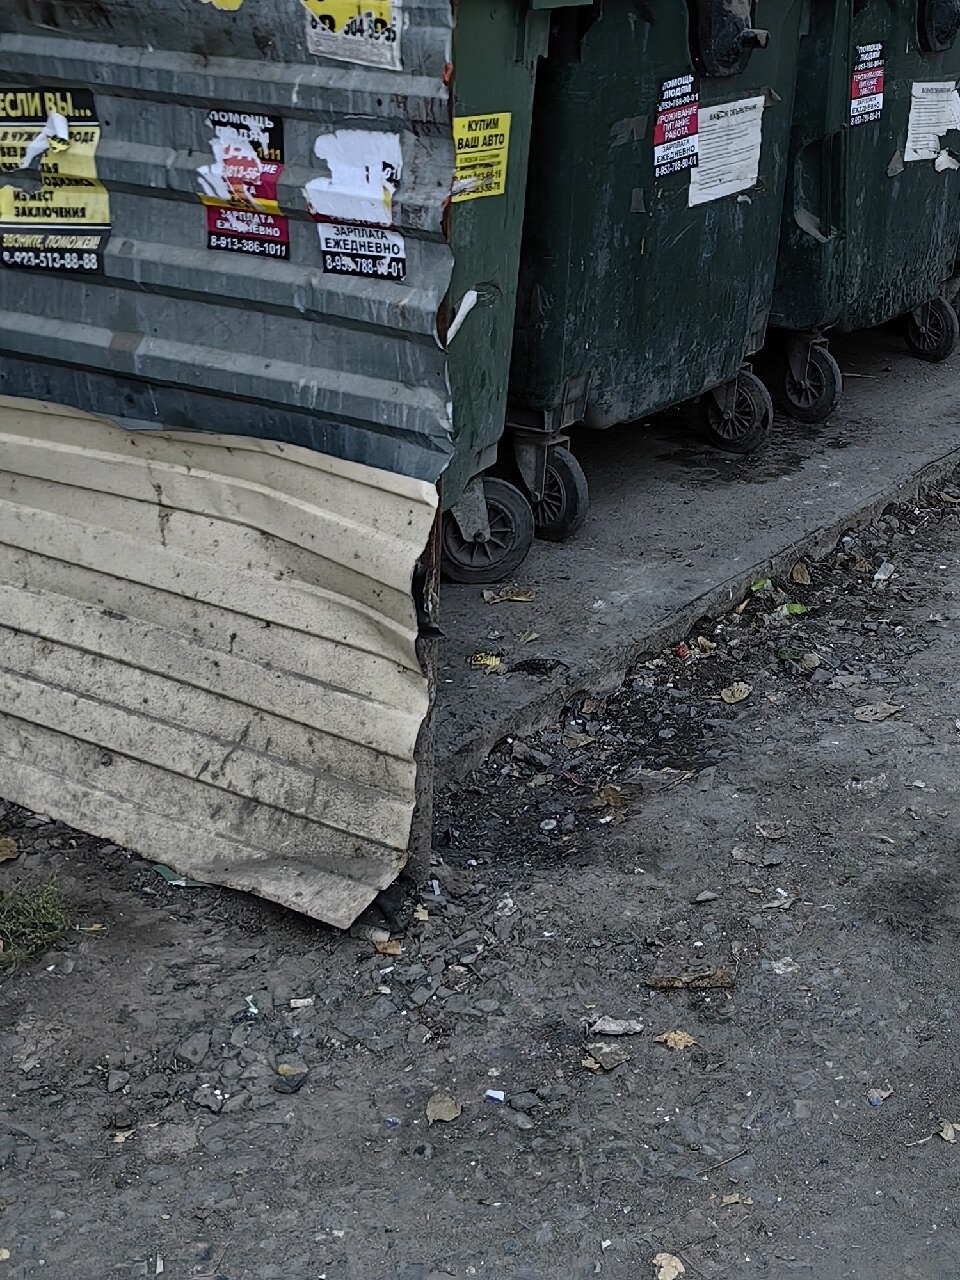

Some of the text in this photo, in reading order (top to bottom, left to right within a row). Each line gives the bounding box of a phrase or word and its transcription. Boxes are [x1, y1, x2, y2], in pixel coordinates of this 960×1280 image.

[0, 92, 43, 118] ЕСЛИ
[467, 117, 500, 132] КУПИМ
[663, 115, 690, 132] ПИТАНИЕ
[457, 133, 505, 150] ВАШ АВТО
[664, 126, 689, 141] РАБОТА
[14, 206, 86, 219] ЗАКЛЮЧЕНИЯ
[221, 209, 275, 225] ЗАРПЛАТА
[333, 226, 389, 241] ЗАРПЛАТА
[210, 235, 286, 257] 8-913-386-1011
[325, 237, 400, 256] ЕЖЕДНЕВНО
